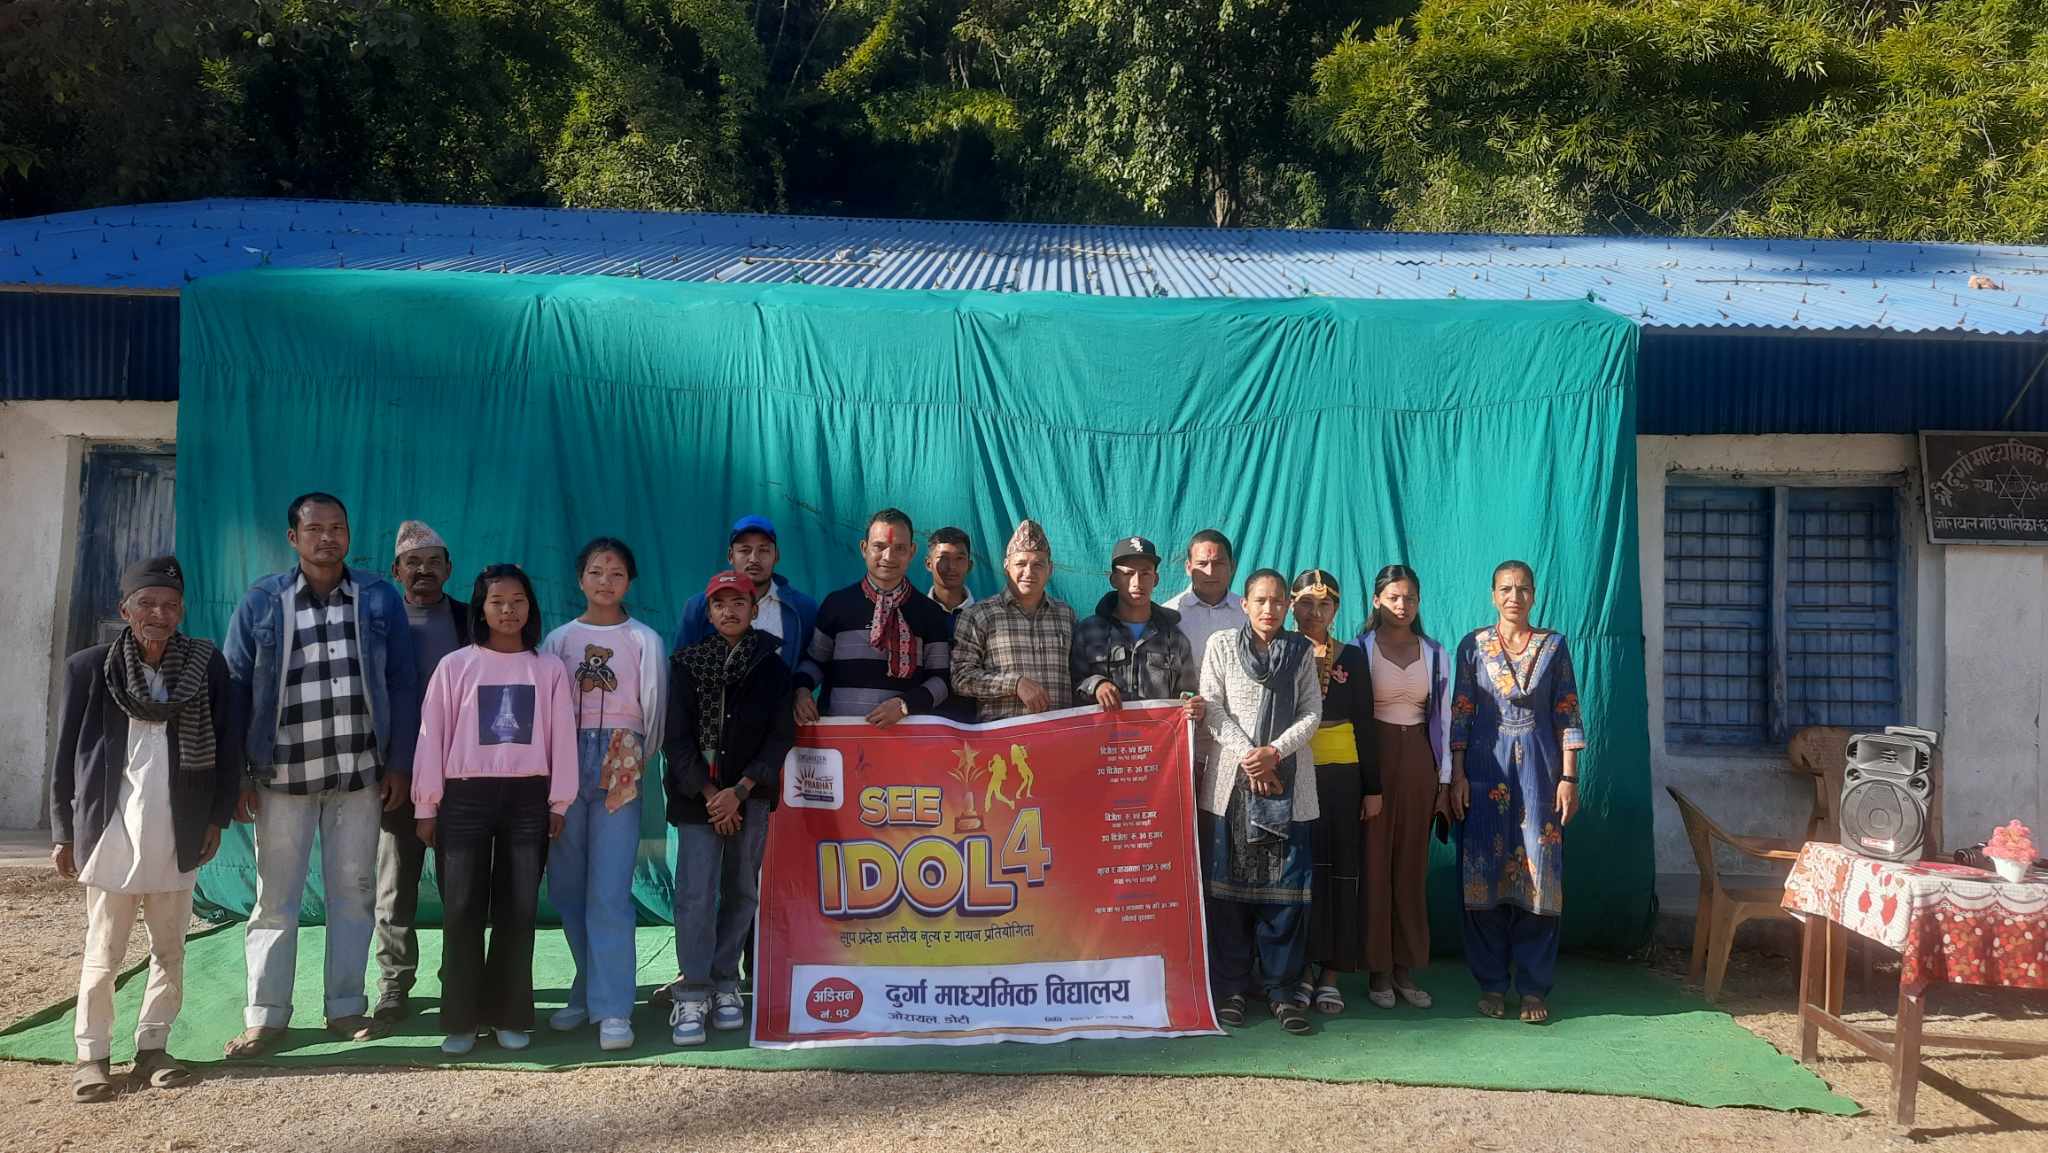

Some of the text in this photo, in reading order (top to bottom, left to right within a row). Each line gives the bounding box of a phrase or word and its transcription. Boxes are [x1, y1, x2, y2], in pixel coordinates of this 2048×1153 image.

[1968, 438, 2045, 466] माध्यमिक
[858, 785, 943, 828] SEE
[817, 806, 1053, 920] IDOL 4
[859, 928, 882, 945] प्रदेश
[886, 926, 917, 944] स्तरीय
[920, 930, 942, 948] नृत्य
[943, 930, 952, 942] र
[954, 930, 981, 943] गायन
[984, 921, 1035, 942] प्रतियोगिता
[813, 986, 855, 1003] अडिसन
[885, 975, 1130, 1009] दुर्गा माध्यमिक विद्यालय
[836, 1007, 850, 1018] १२
[943, 1013, 970, 1025] डोटी
